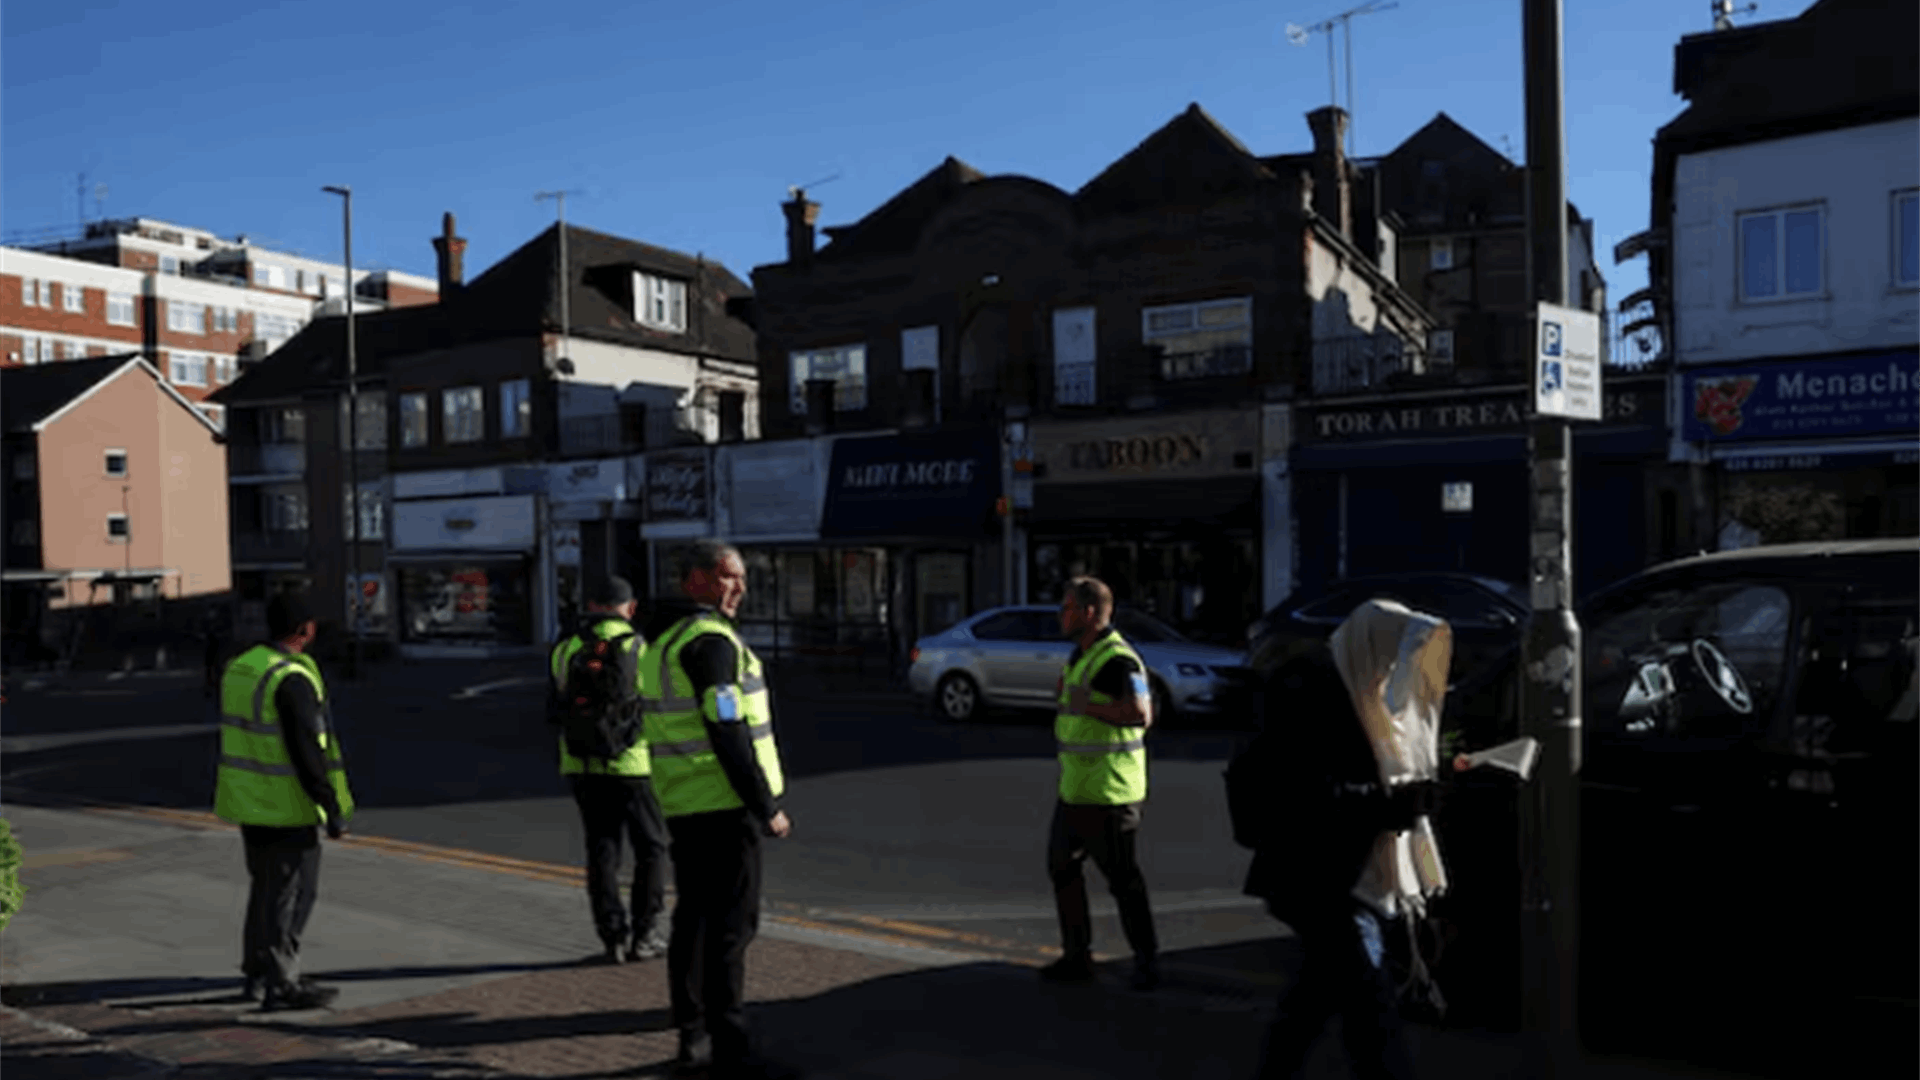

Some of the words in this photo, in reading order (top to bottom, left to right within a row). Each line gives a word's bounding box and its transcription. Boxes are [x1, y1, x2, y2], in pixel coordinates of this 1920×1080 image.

[1315, 409, 1421, 435] TORAH
[1431, 392, 1638, 426] TREAES
[1068, 434, 1202, 469] TABOON
[901, 458, 978, 486] MODE
